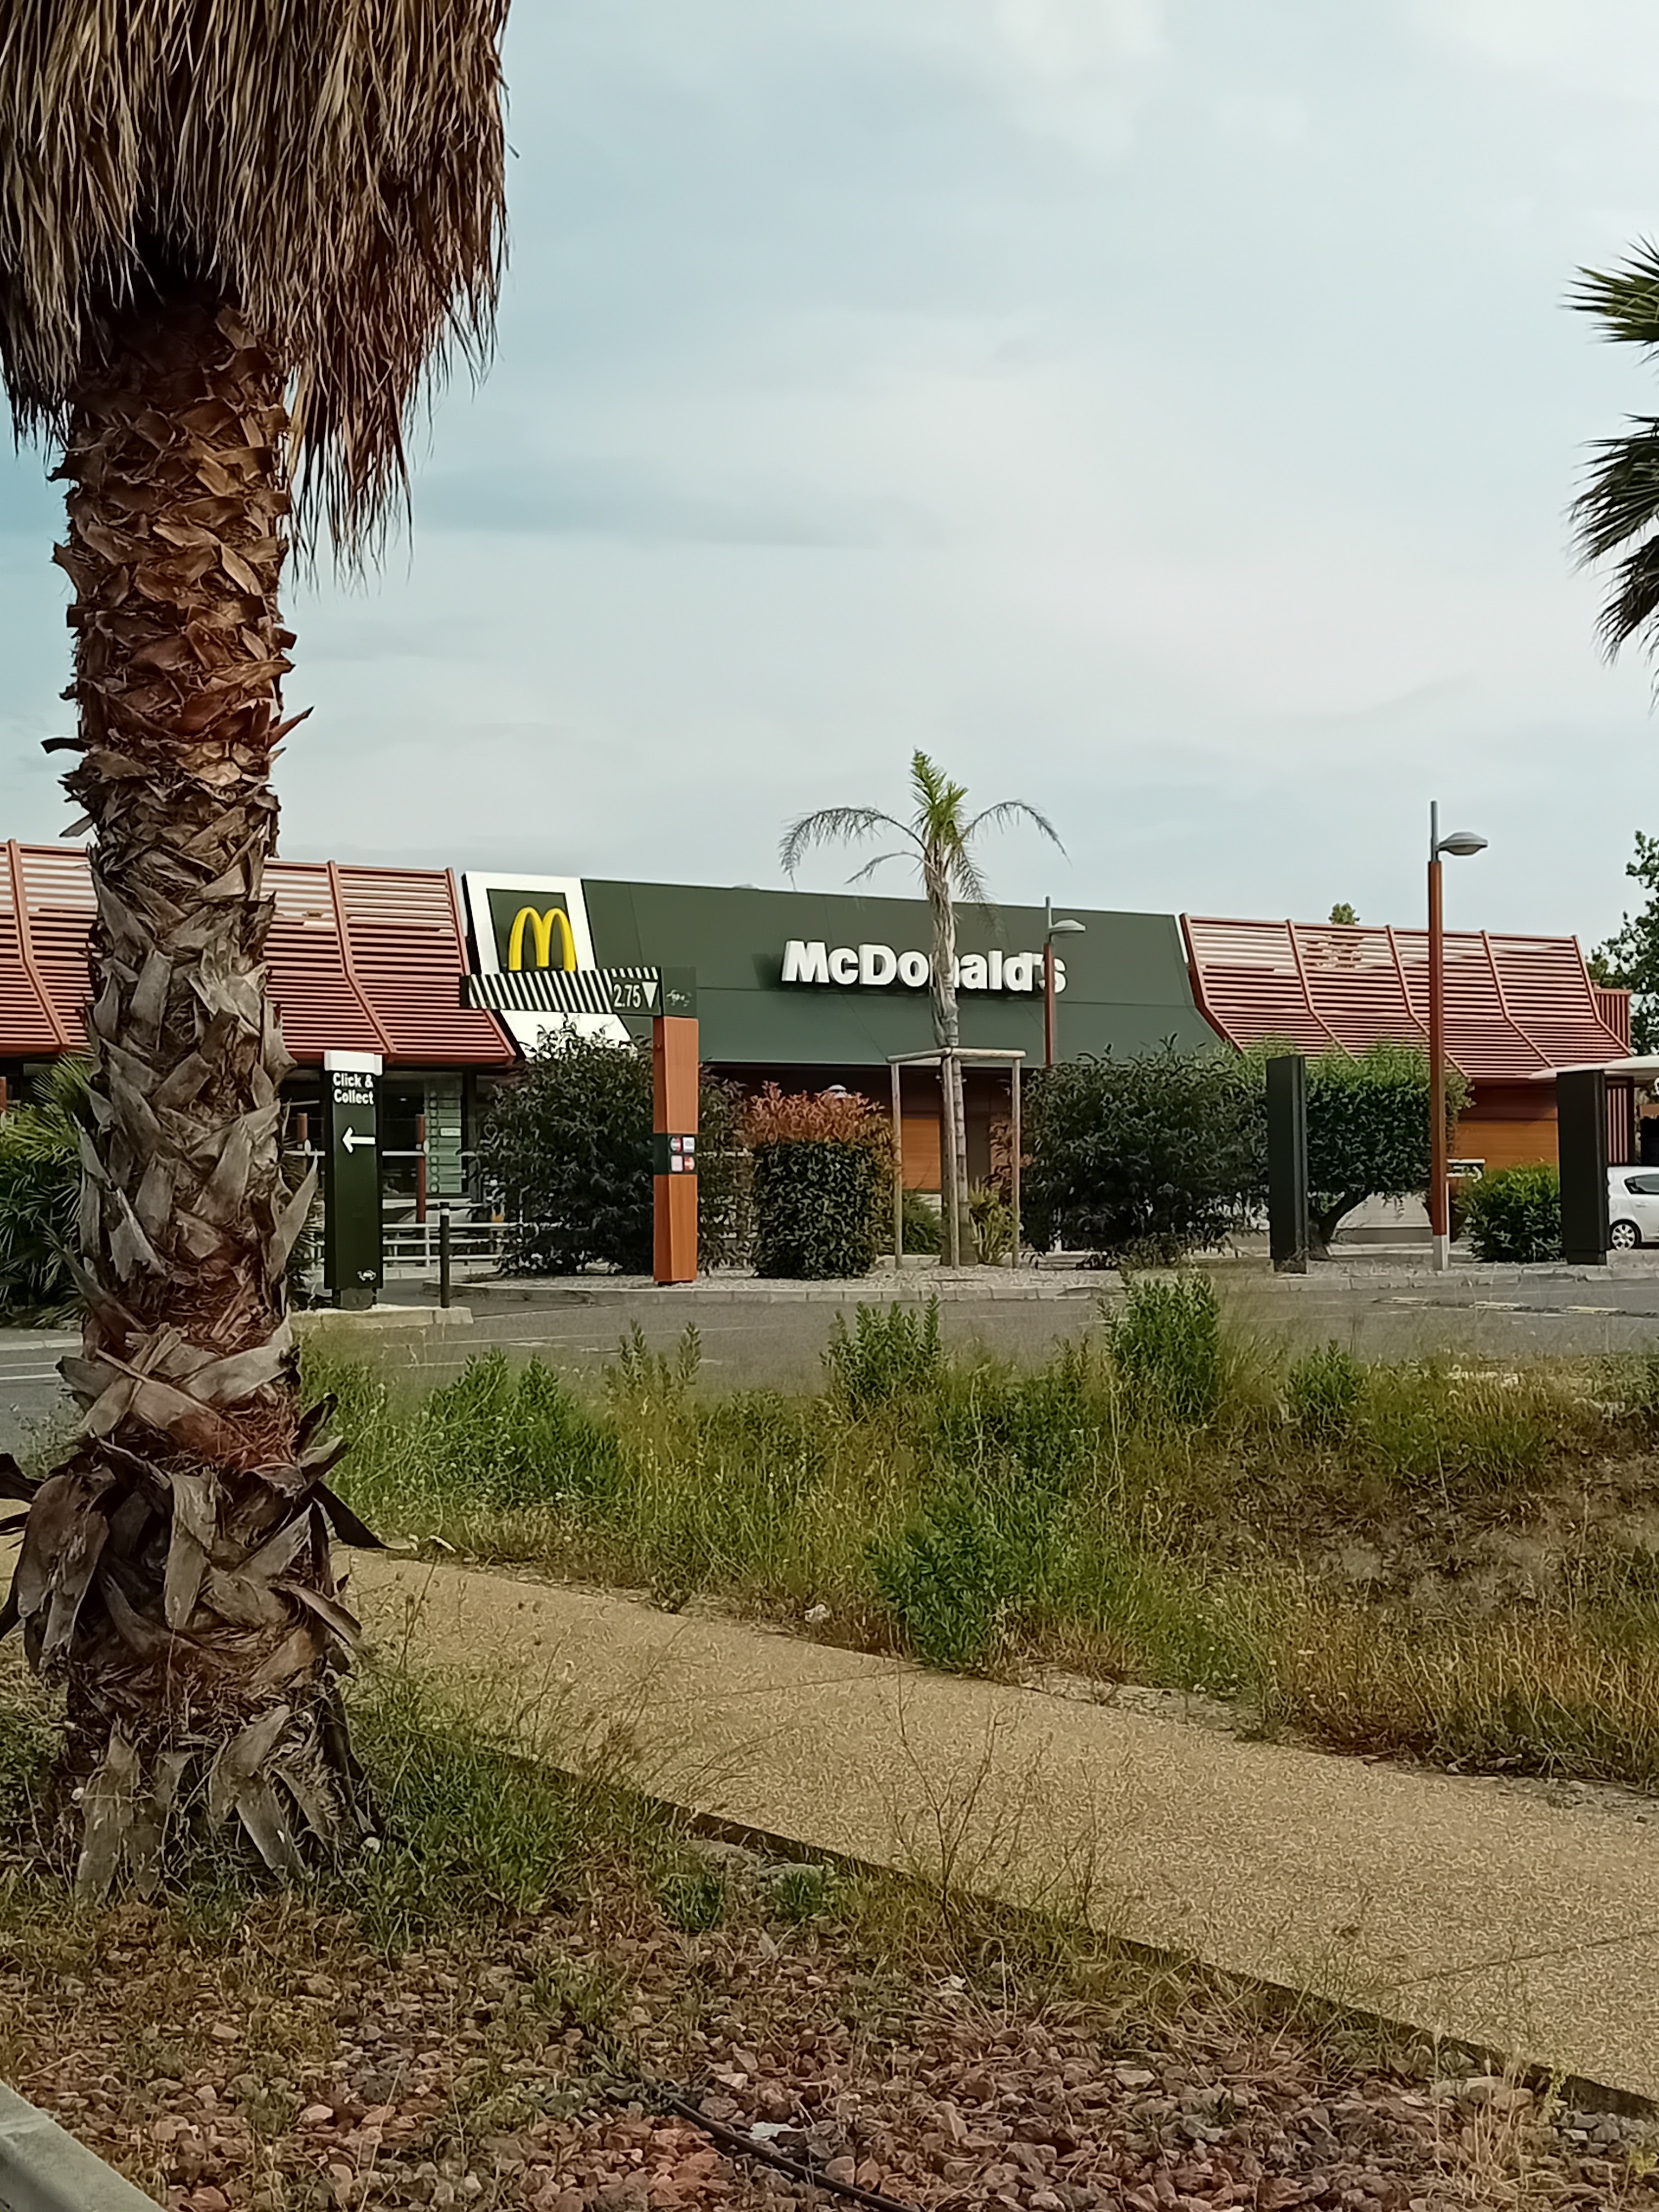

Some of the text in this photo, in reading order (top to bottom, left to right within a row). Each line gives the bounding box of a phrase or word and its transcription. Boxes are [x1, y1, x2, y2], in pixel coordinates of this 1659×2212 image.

[614, 984, 641, 1008] 2.75
[333, 1072, 374, 1088] Click &
[334, 1089, 374, 1104] Collect
